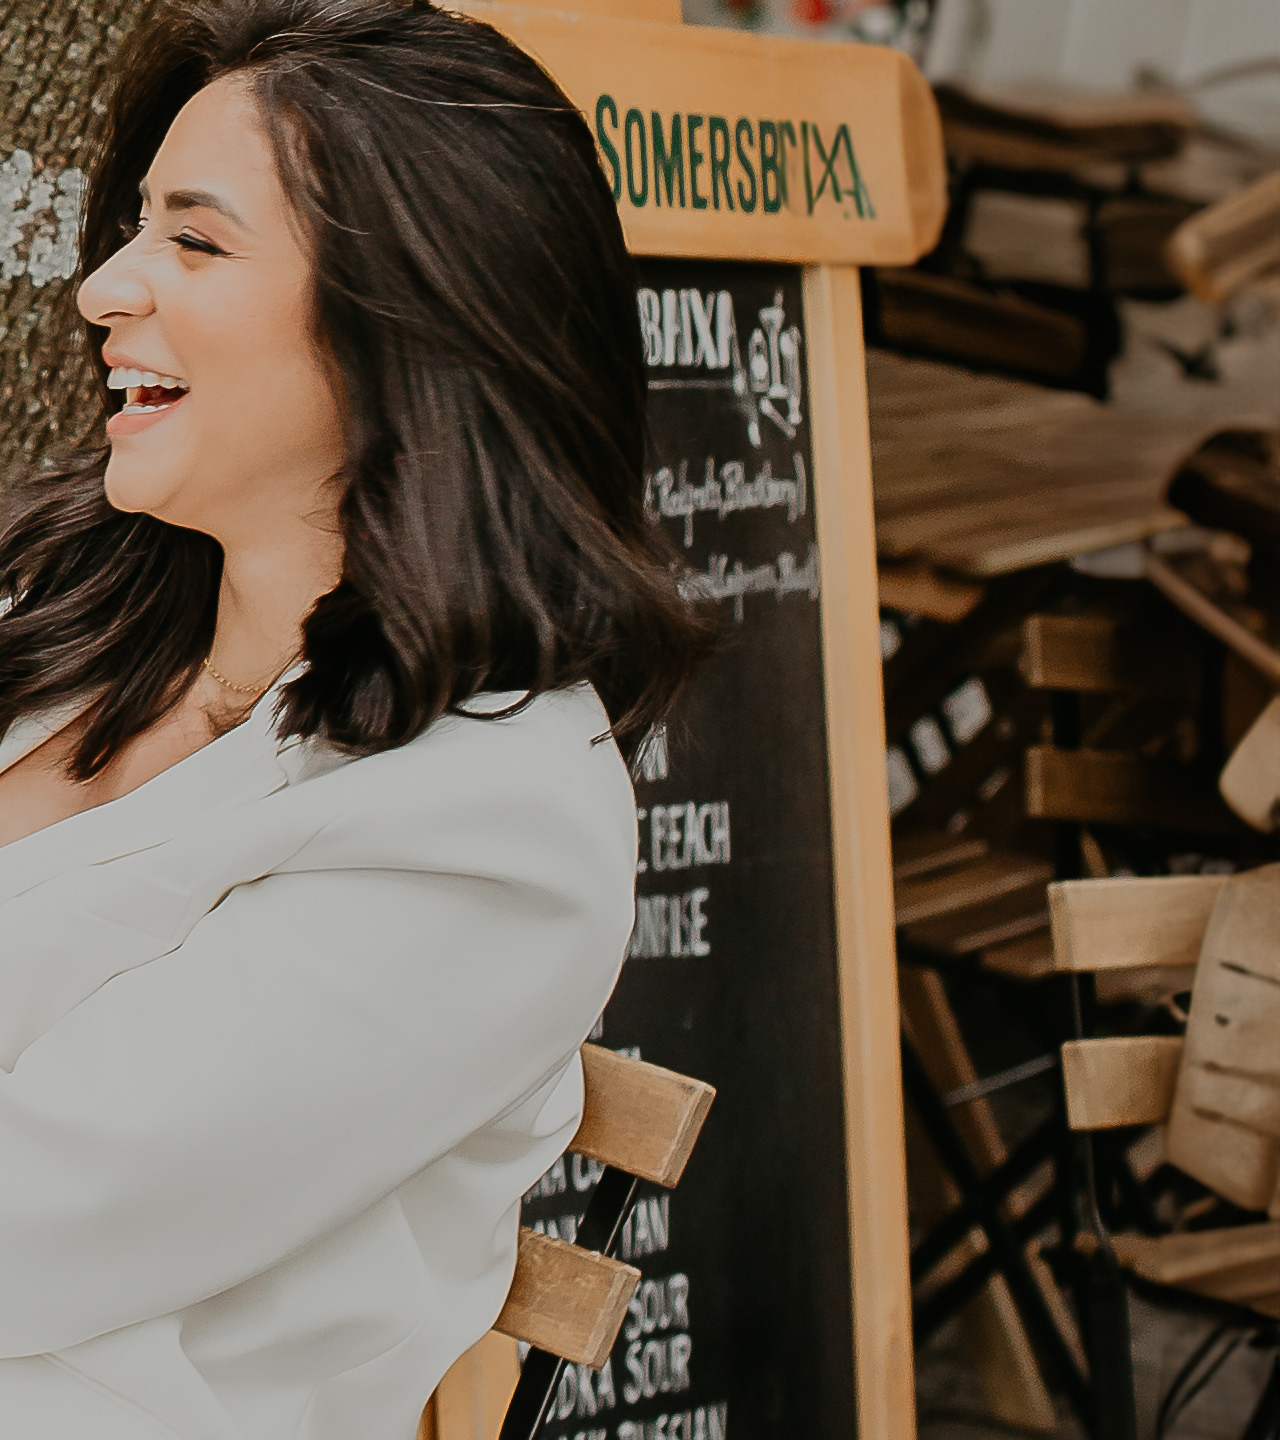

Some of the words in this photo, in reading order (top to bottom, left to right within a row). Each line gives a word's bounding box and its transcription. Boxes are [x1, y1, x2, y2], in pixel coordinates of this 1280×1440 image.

[651, 800, 731, 870] BEACH
[623, 886, 711, 960] NRISE
[626, 1272, 689, 1341] SOUR
[624, 1333, 692, 1405] SOUR
